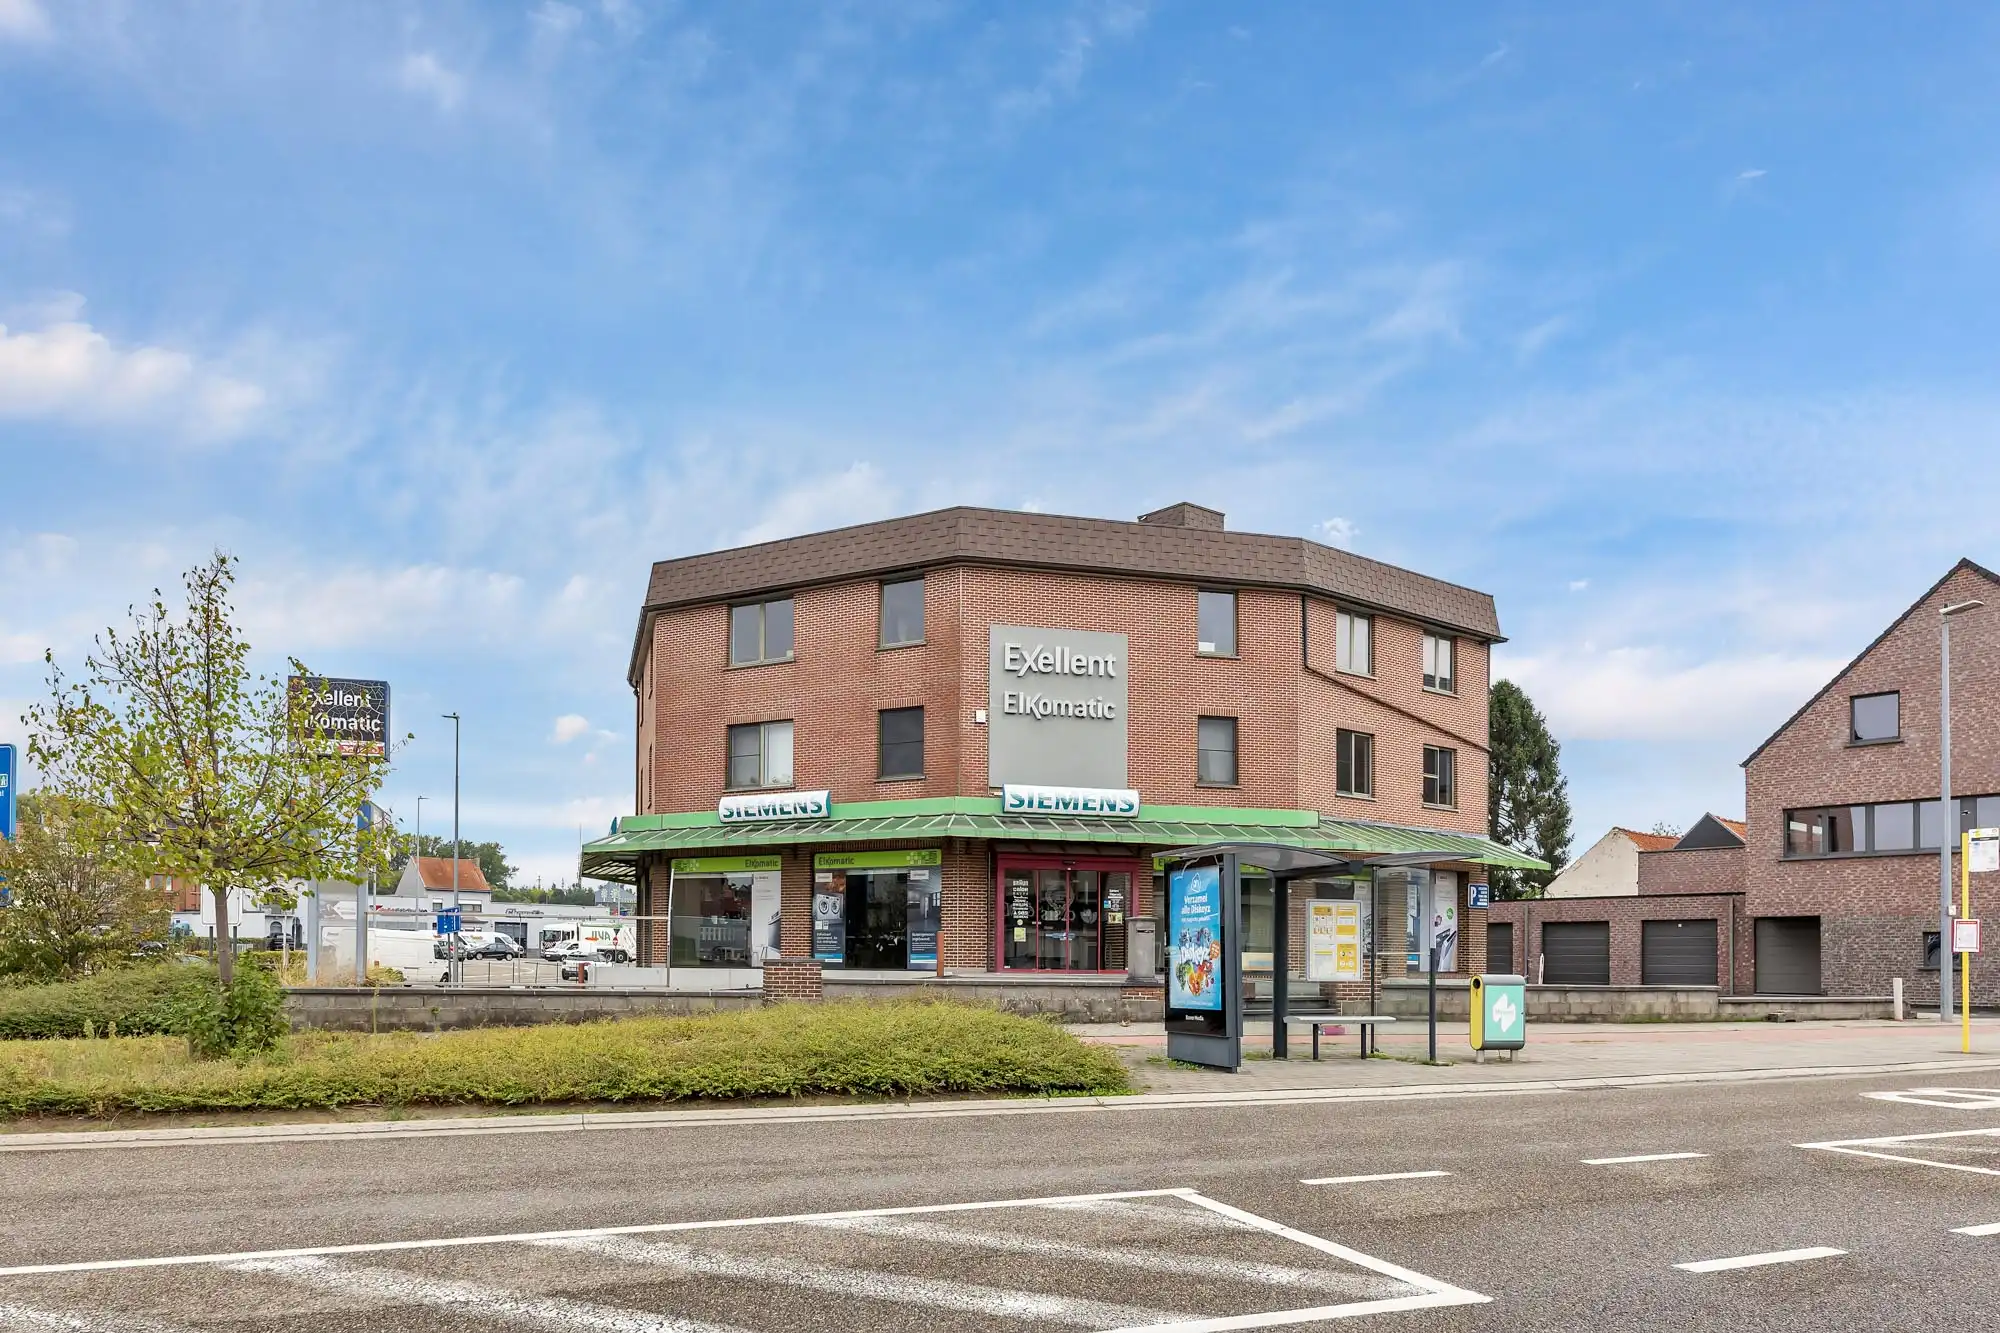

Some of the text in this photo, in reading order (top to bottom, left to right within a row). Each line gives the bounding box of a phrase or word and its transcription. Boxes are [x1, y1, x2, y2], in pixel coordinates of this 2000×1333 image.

[723, 800, 823, 819] SIEMENS
[1009, 791, 1135, 813] SIEMENS
[1184, 893, 1208, 904] Verzamel
[1470, 886, 1477, 905] P
